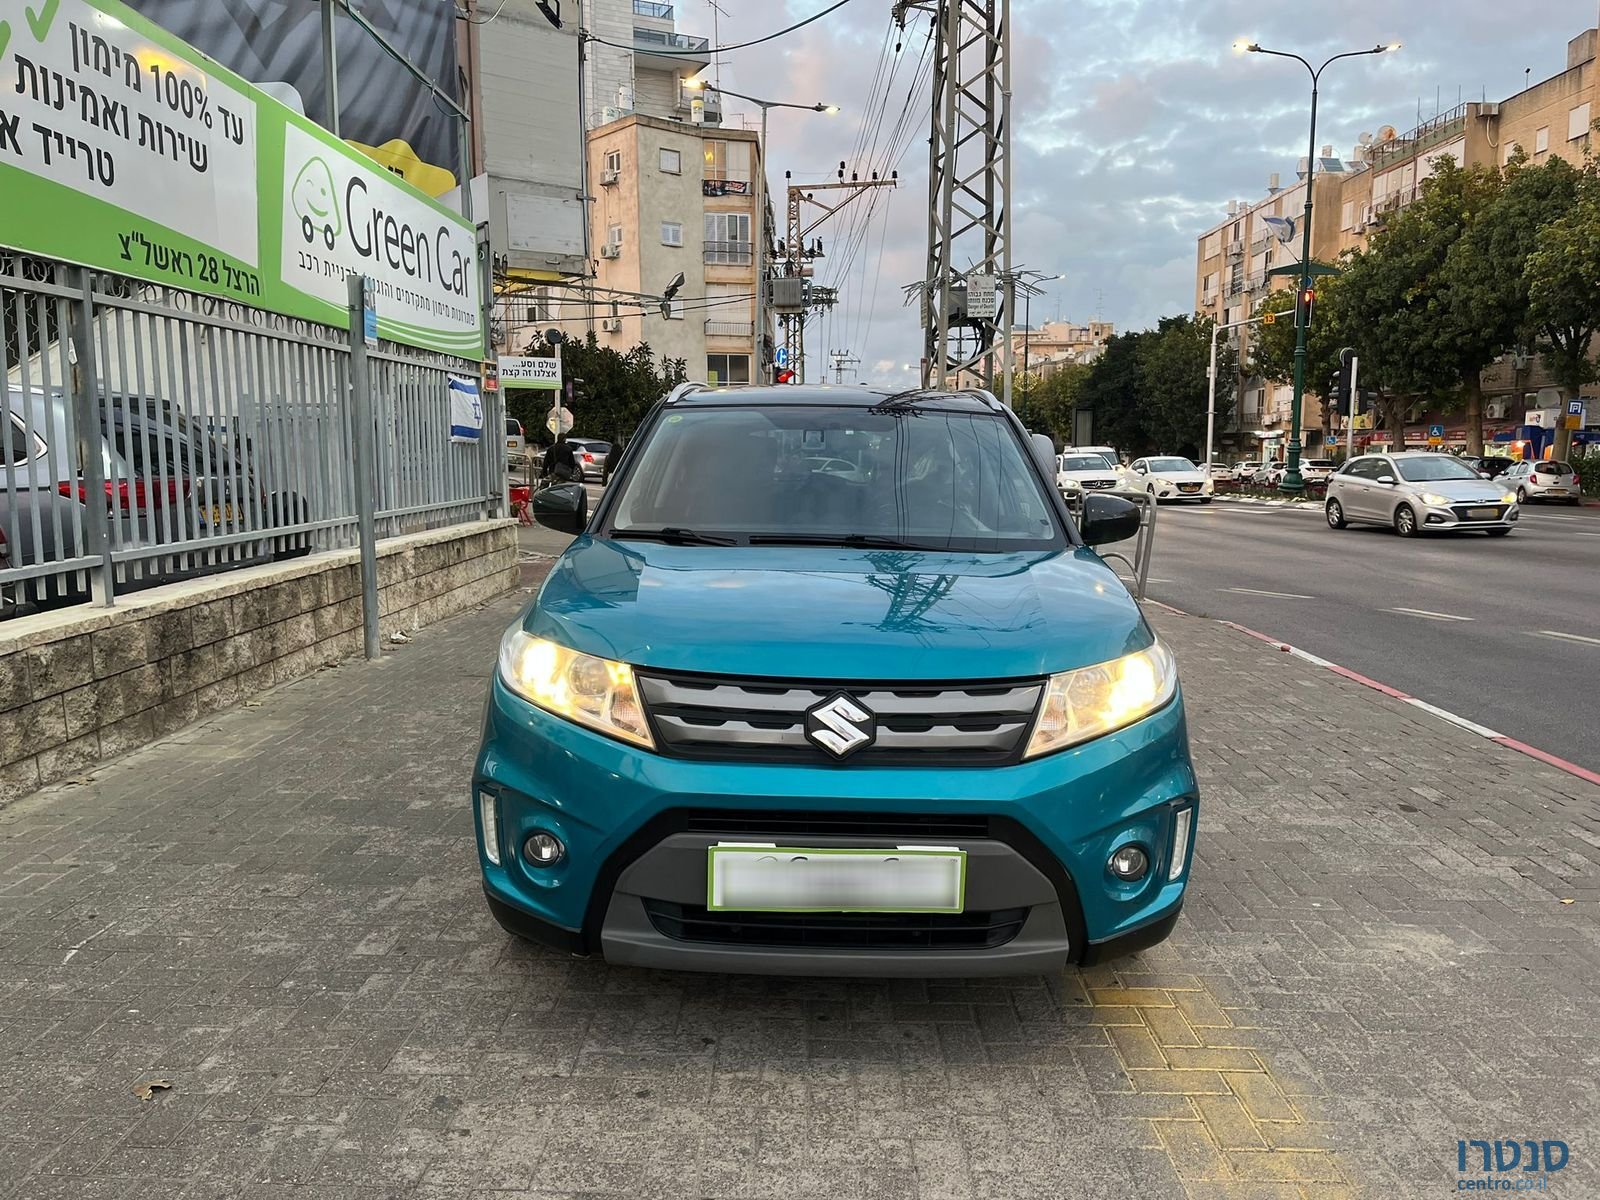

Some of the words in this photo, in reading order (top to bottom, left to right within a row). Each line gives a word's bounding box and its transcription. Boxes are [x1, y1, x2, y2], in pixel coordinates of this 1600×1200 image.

[69, 22, 142, 93] מימון
[15, 53, 130, 140] ואמינות
[151, 65, 213, 130] 100%
[218, 105, 244, 145] עד
[32, 122, 115, 187] טרייד
[138, 112, 208, 173] שירות
[346, 176, 432, 283] Green
[436, 226, 471, 298] Car
[197, 253, 219, 284] 28
[222, 259, 260, 296] הרצל
[298, 250, 319, 274] רכב
[396, 287, 431, 311] מתקדמים
[432, 300, 450, 317] מימון
[451, 307, 475, 326] פתרונות
[502, 368, 520, 378] קצת
[522, 369, 532, 377] זה
[534, 369, 557, 378] אצלנו
[538, 360, 557, 369] שלם
